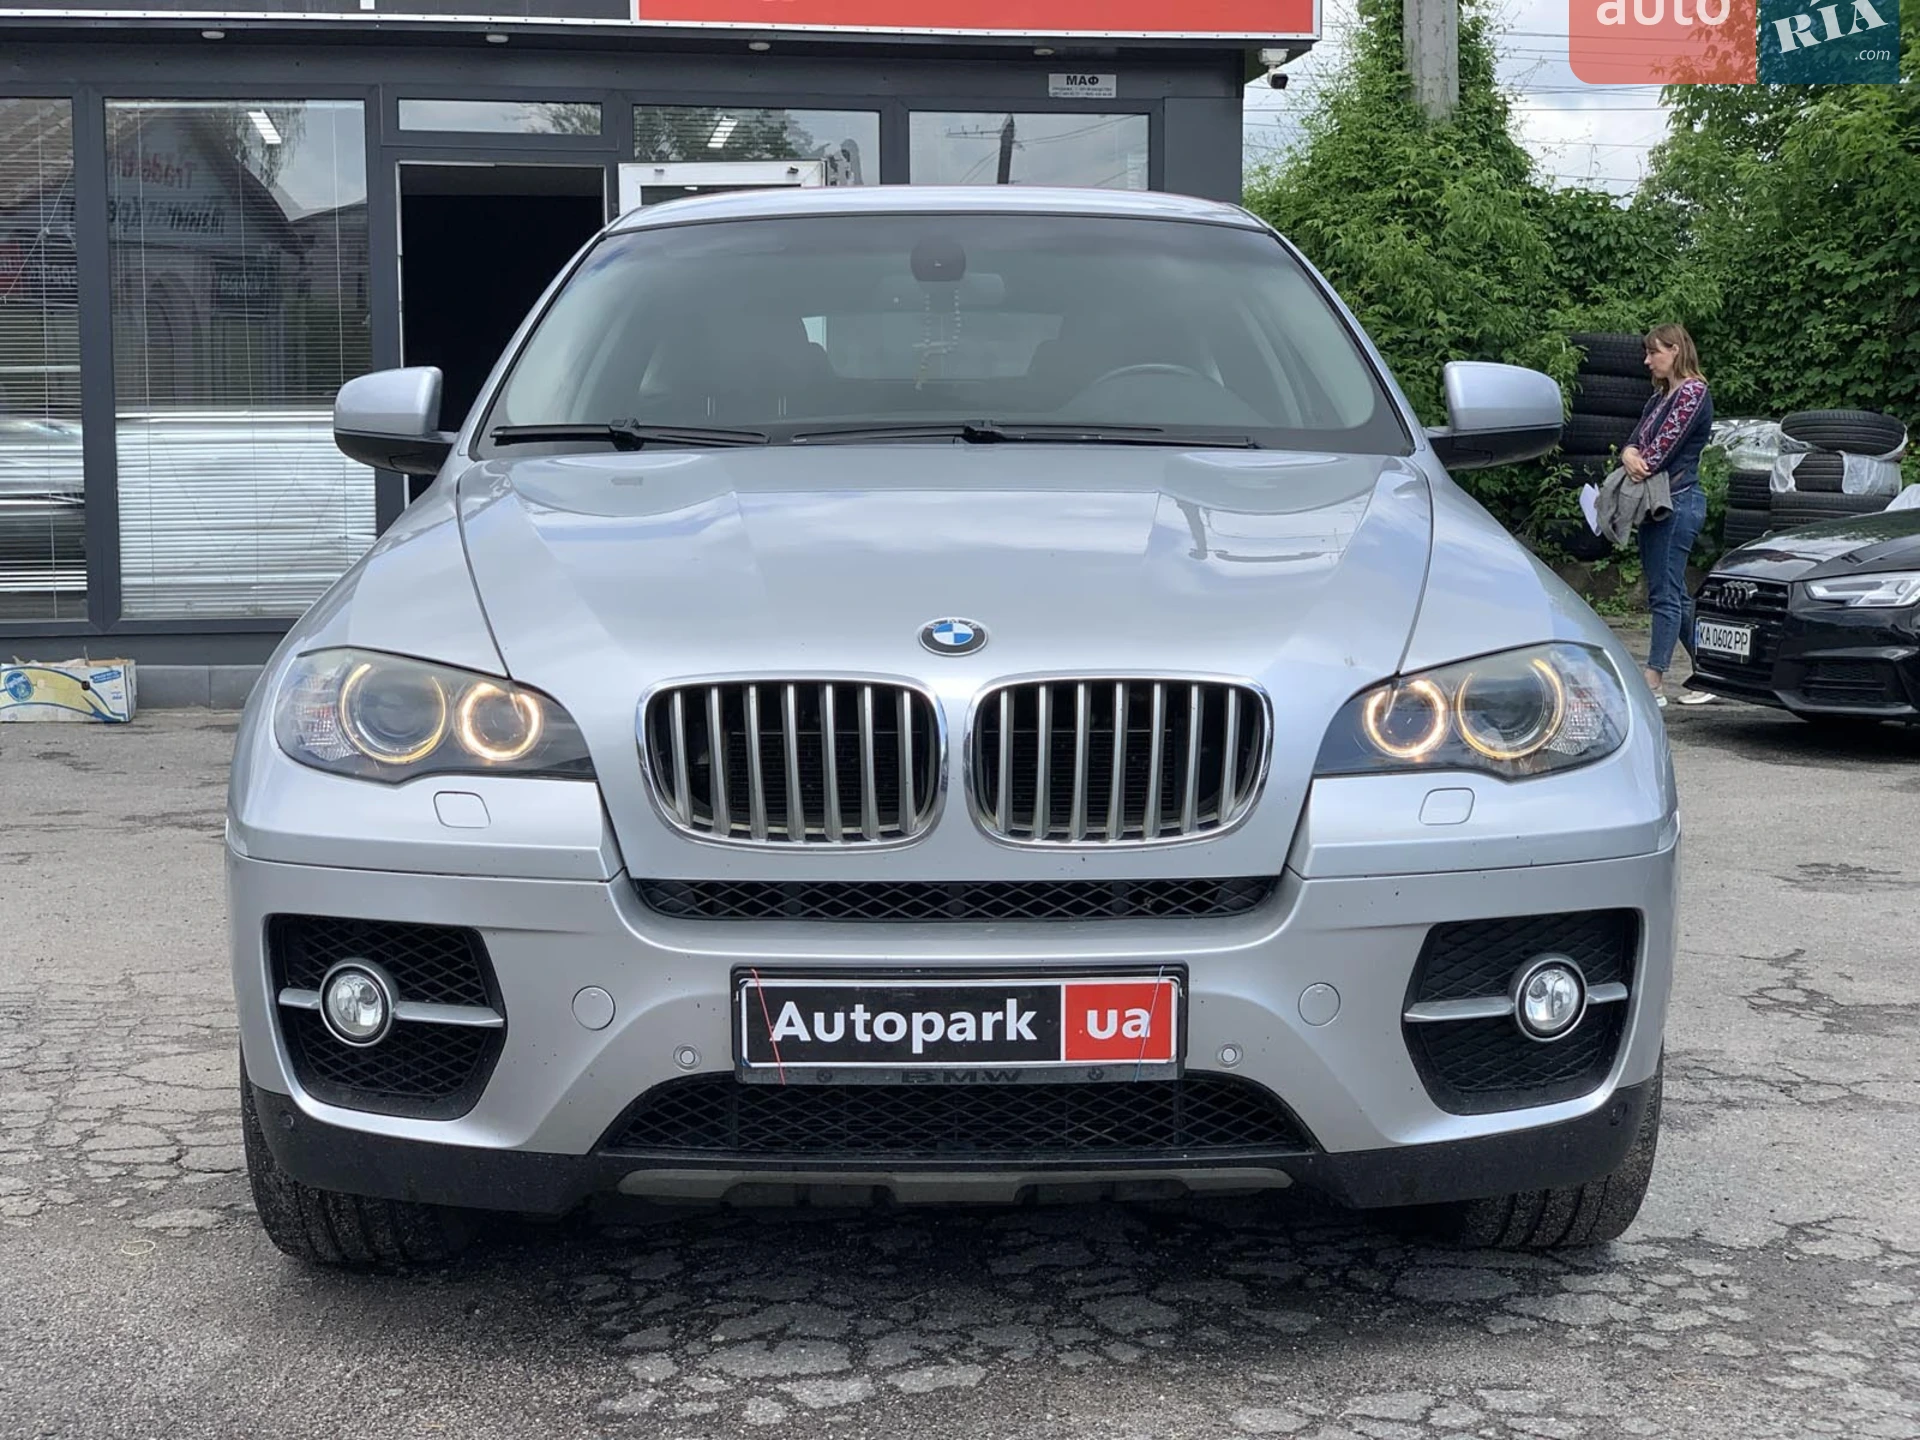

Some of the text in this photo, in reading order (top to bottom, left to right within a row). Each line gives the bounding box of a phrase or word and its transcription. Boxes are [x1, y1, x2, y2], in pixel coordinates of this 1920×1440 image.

[1066, 75, 1099, 86] МАФ
[1699, 625, 1749, 652] KA 0602 PP
[770, 998, 1152, 1055] Autopark ua
[902, 1069, 1022, 1083] BMW
